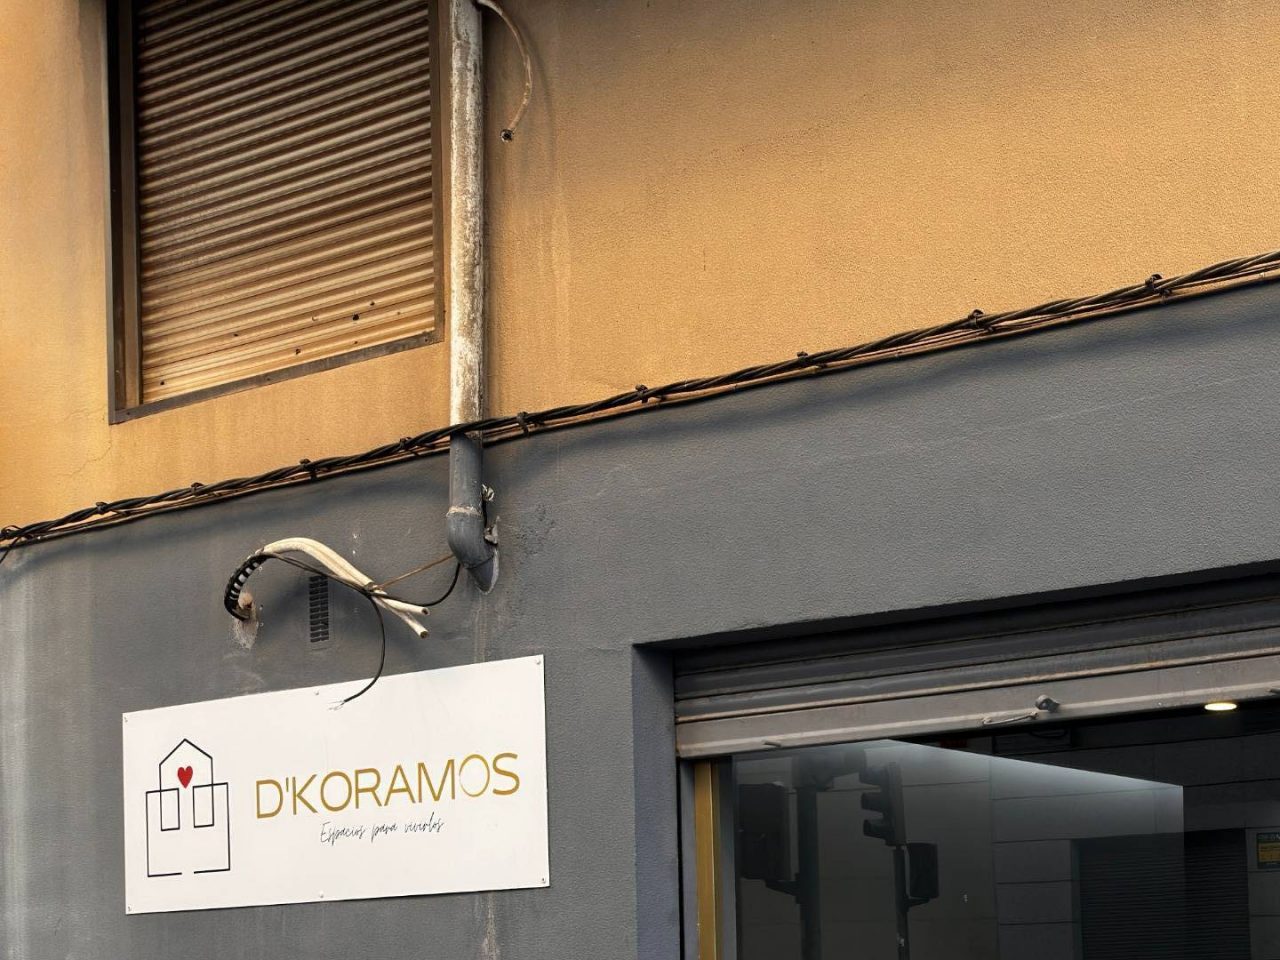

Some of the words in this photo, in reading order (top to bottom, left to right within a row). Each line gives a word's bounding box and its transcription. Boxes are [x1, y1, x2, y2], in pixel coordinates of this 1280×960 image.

[256, 752, 521, 820] D'KORAMOS
[320, 821, 366, 846] Espacios
[371, 822, 398, 843] para
